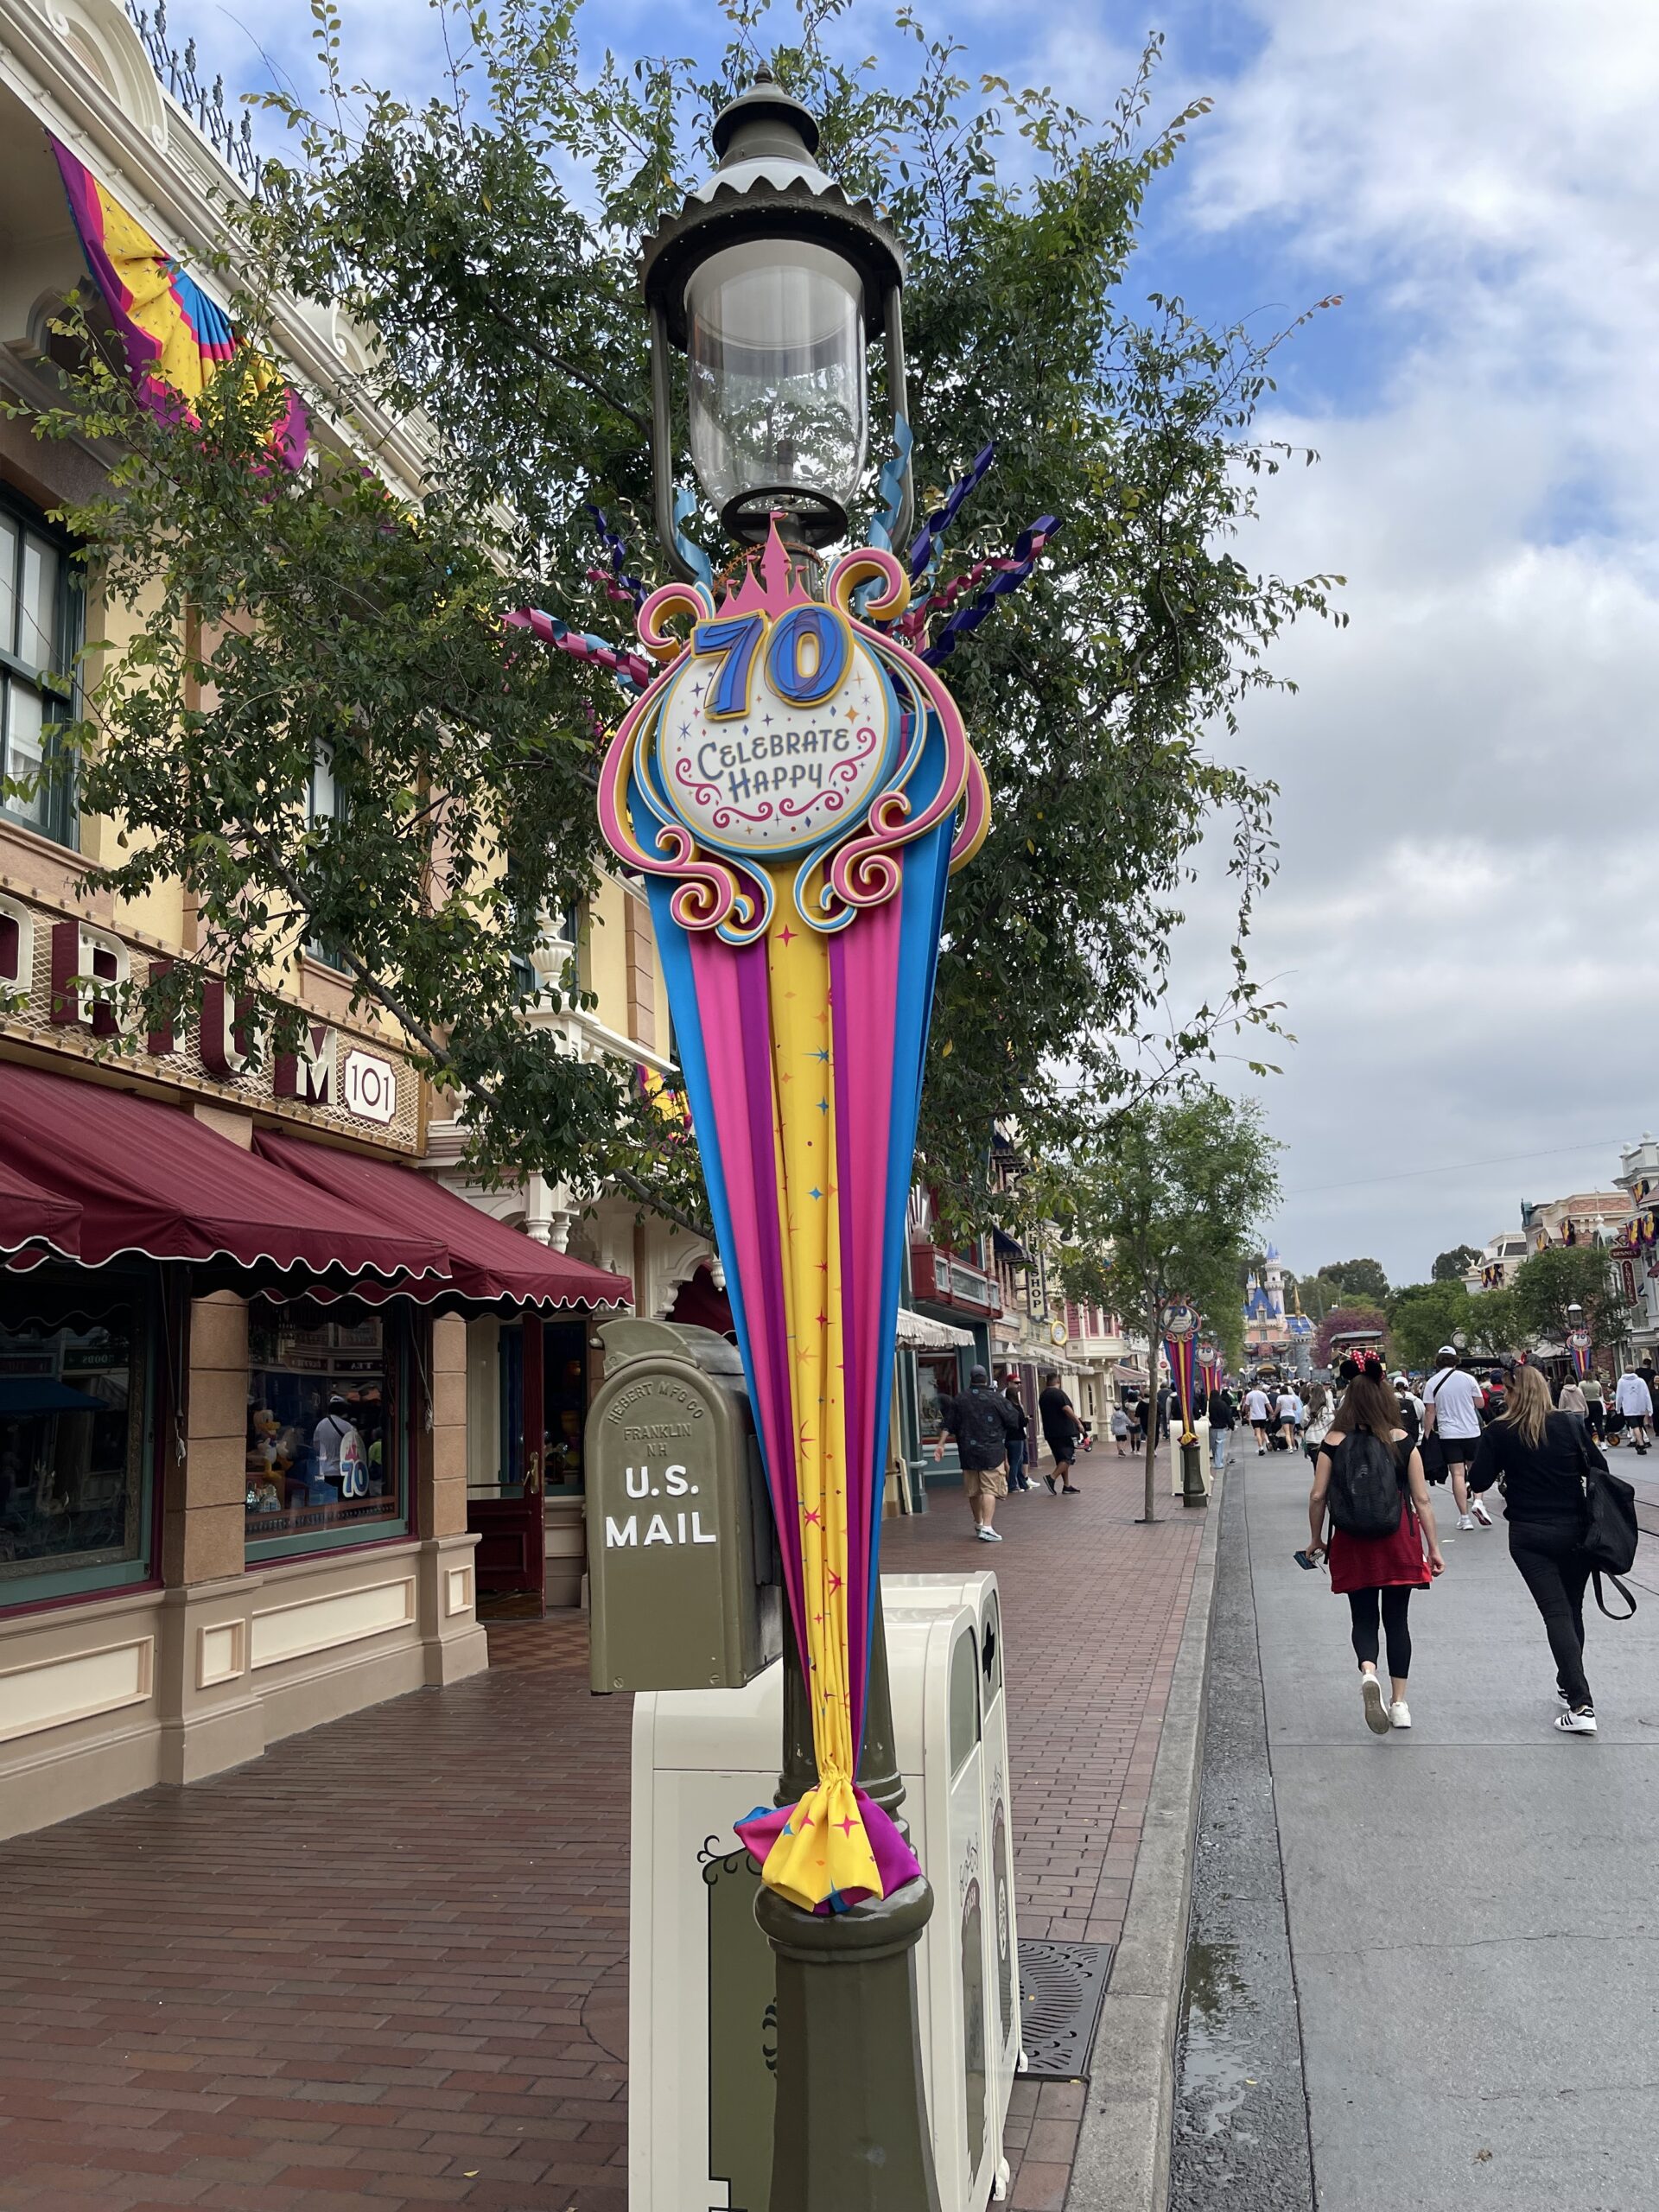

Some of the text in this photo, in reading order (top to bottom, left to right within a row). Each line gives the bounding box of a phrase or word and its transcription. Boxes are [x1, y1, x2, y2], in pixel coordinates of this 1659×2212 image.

[690, 602, 854, 721] 70
[696, 728, 850, 781] CELEBRATE
[728, 763, 823, 804] HAPPY
[351, 1064, 391, 1112] 101
[607, 1382, 653, 1425] HEBERT
[687, 1398, 704, 1419] CO
[624, 1423, 691, 1441] FRANKLIN
[340, 1460, 369, 1497] 70
[625, 1465, 700, 1499] U.S.
[606, 1511, 717, 1548] MAIL
